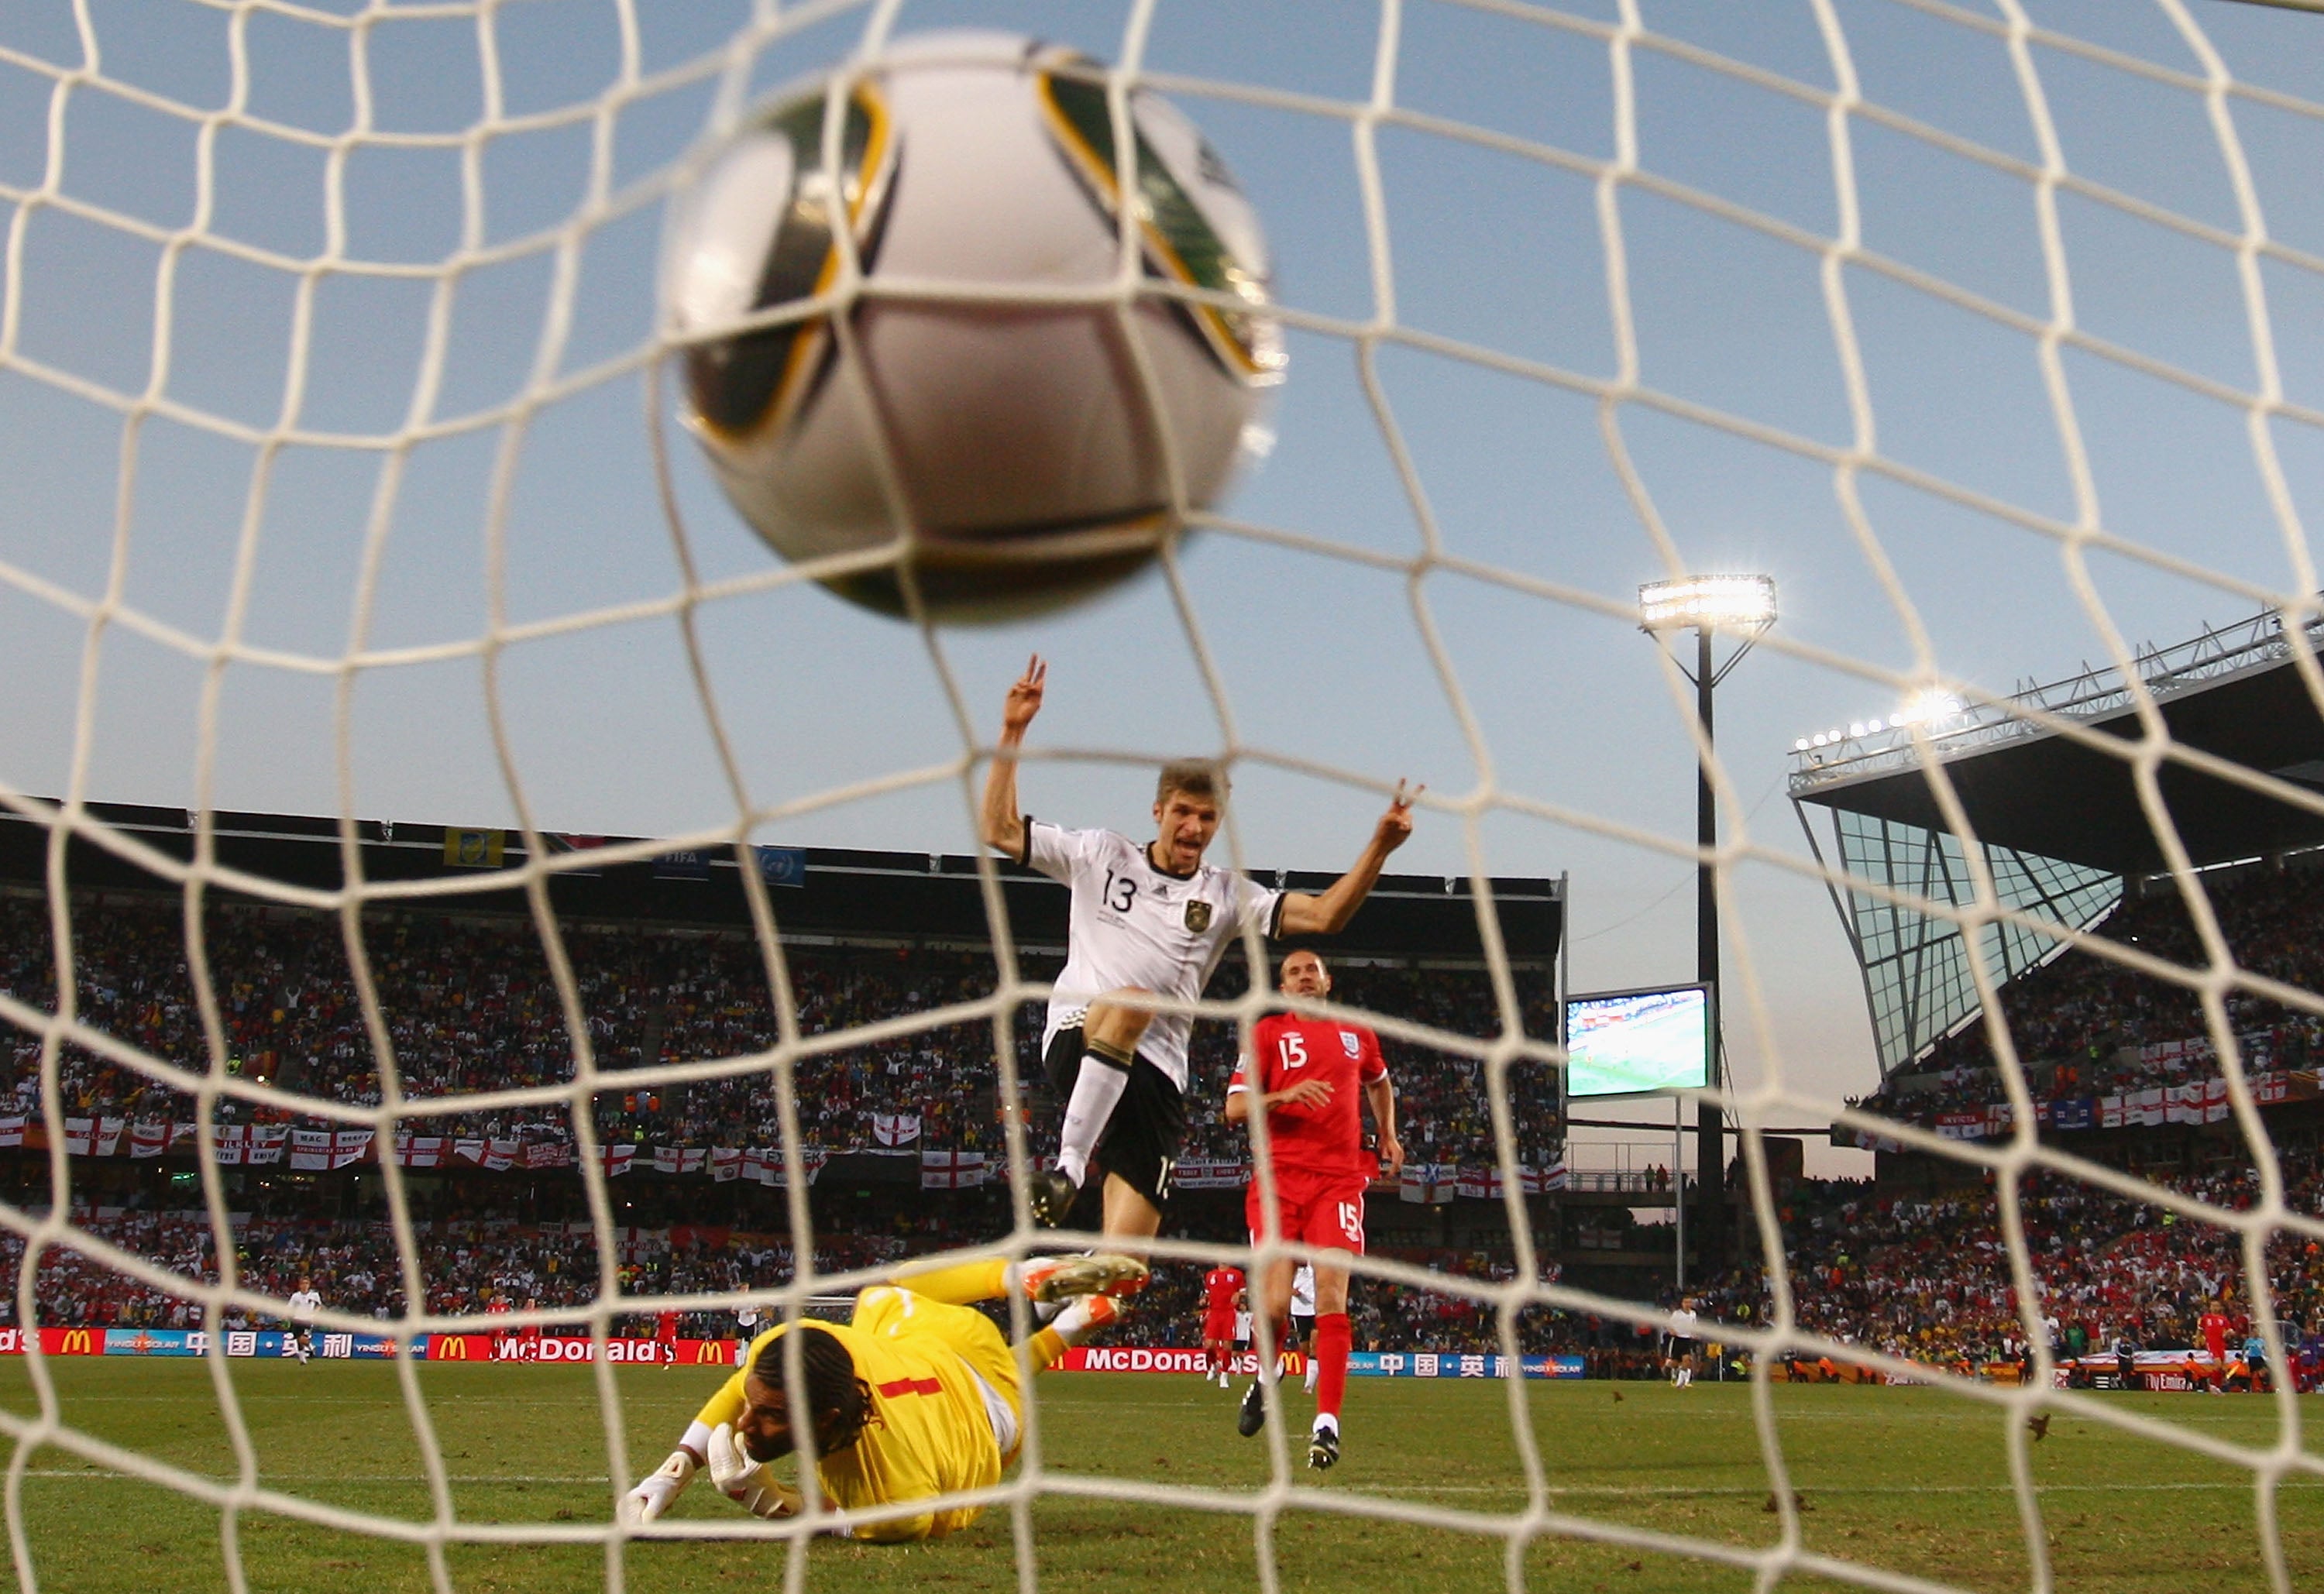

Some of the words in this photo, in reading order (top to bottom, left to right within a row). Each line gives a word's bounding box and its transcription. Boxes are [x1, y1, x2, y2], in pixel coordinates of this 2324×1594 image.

[1103, 868, 1137, 912] 13
[1278, 1037, 1308, 1071] 15
[767, 1151, 820, 1163] EXER
[1338, 1201, 1359, 1233] 15
[2146, 1373, 2159, 1391] Fly
